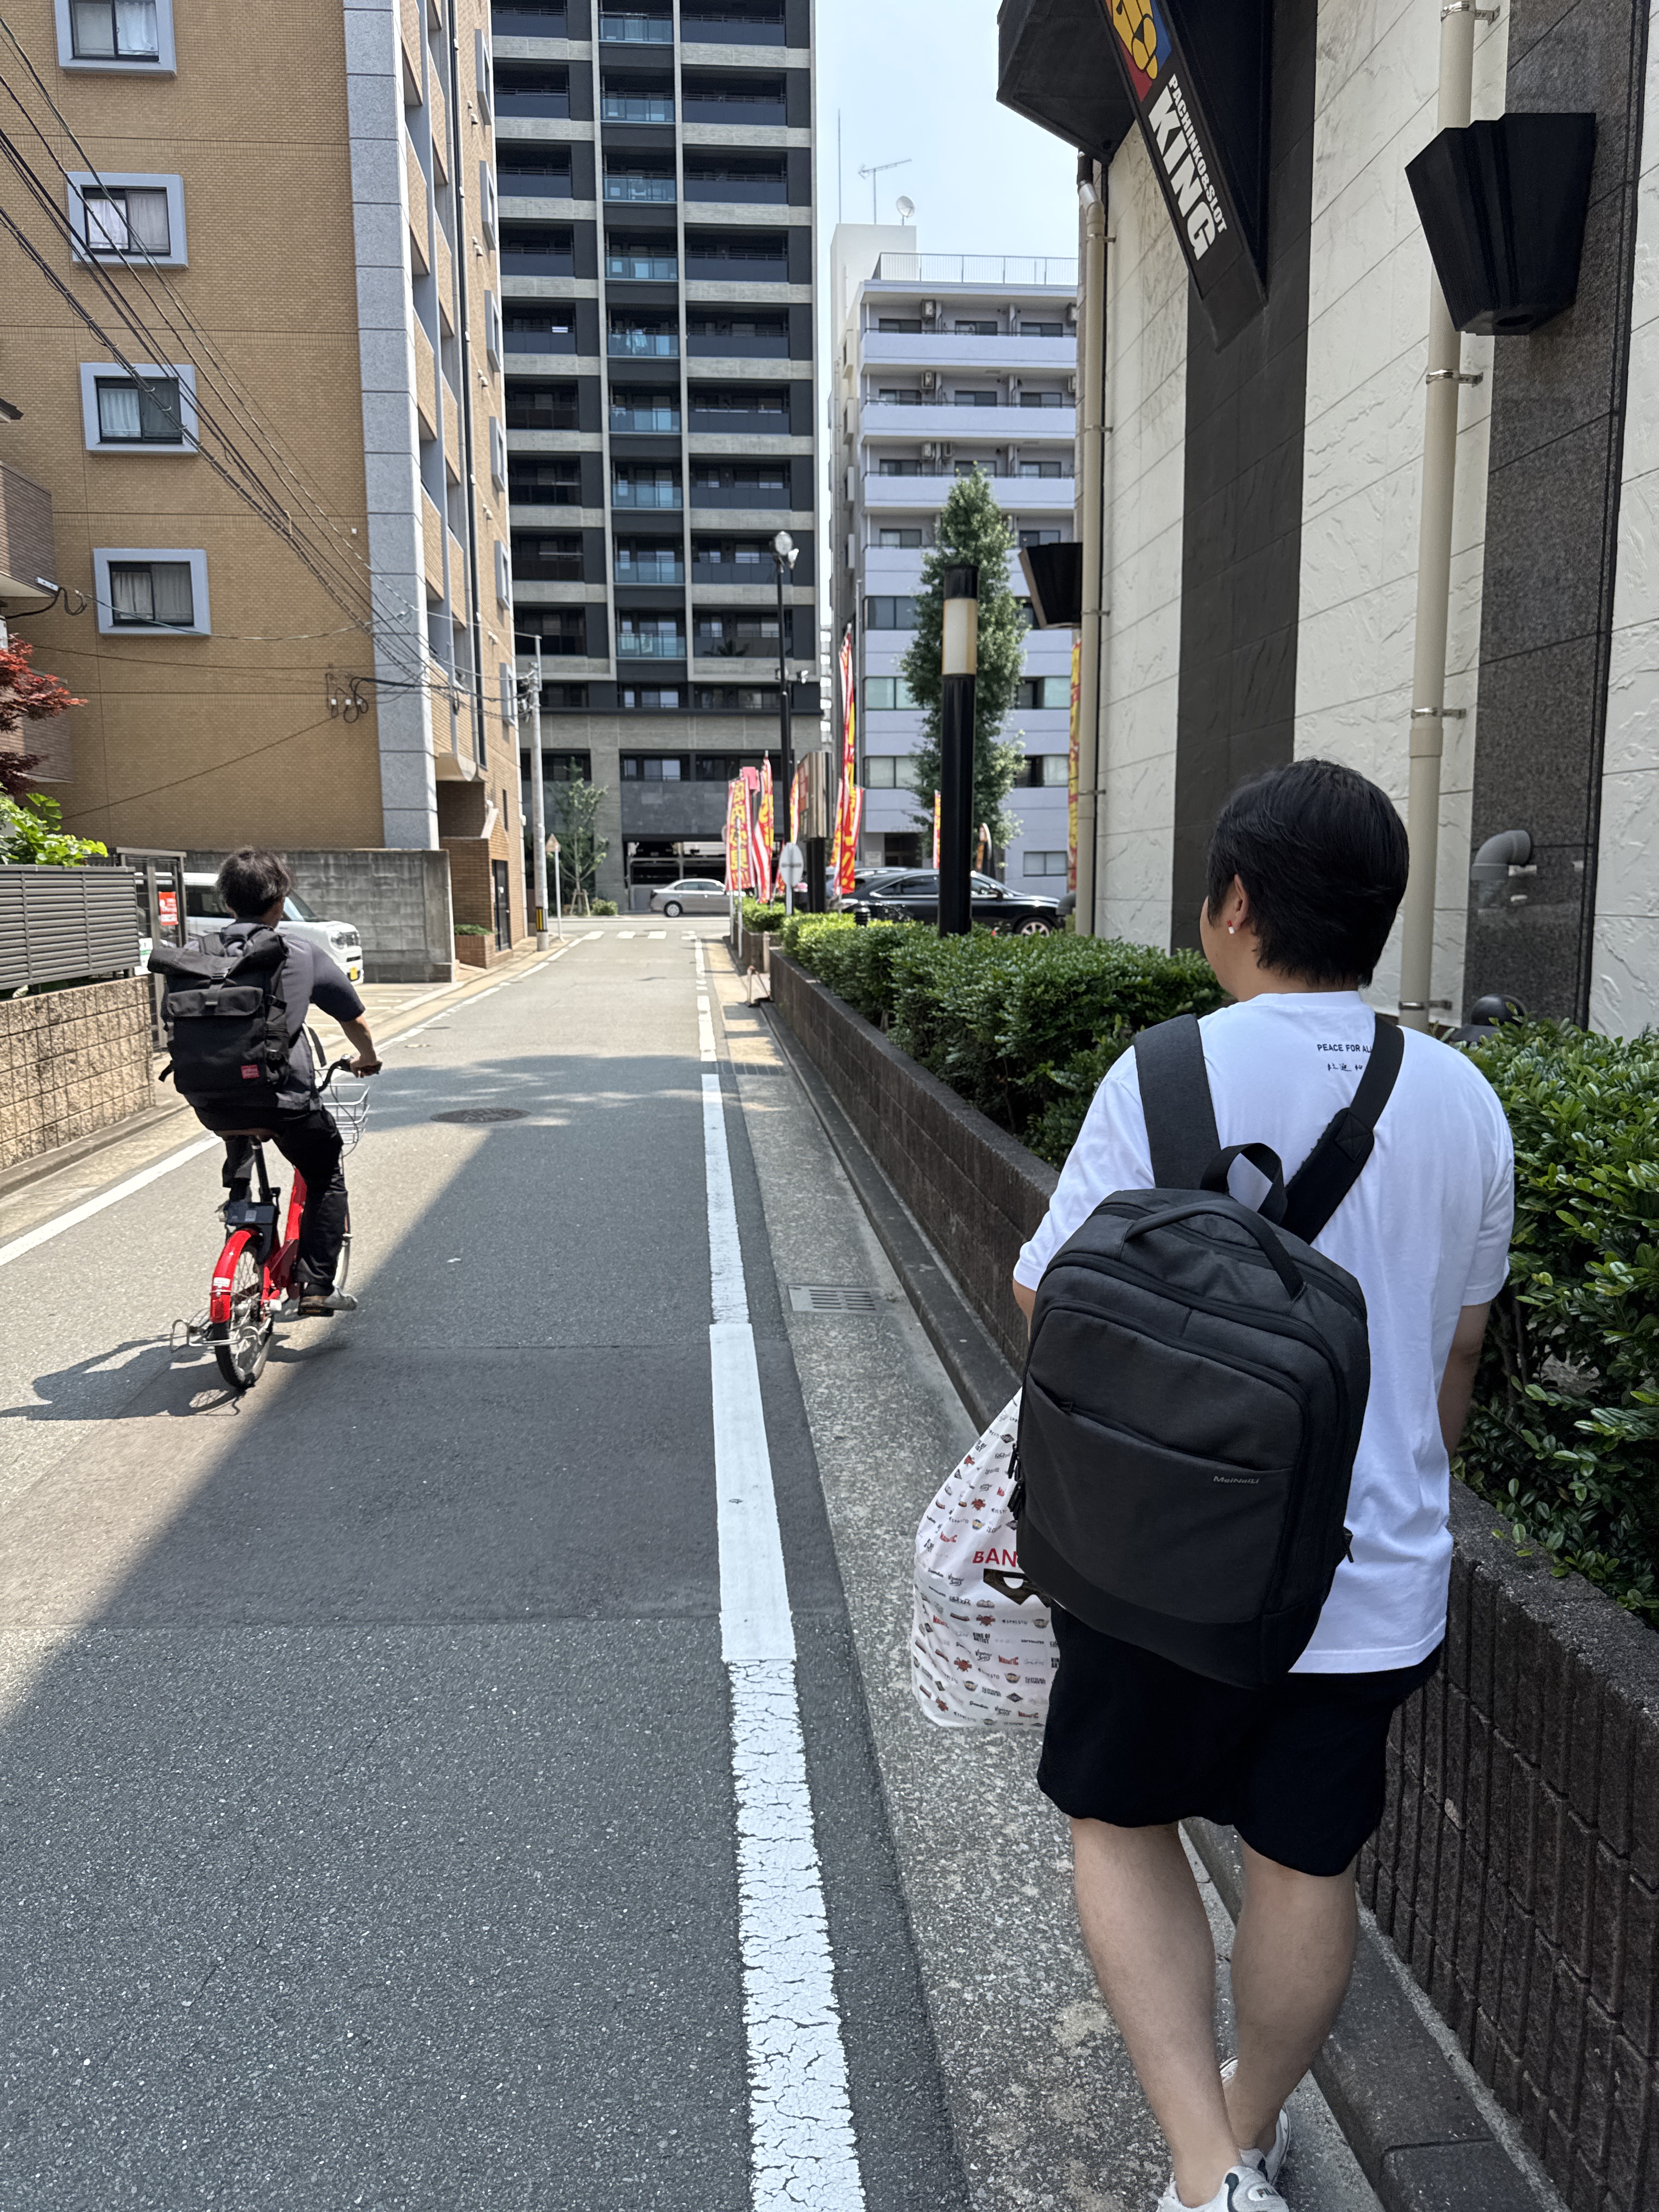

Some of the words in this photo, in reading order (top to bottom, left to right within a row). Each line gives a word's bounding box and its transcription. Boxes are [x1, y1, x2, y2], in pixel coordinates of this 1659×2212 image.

[1148, 86, 1215, 261] KING
[1168, 74, 1227, 233] PACHINKO&SLOT
[1346, 1044, 1361, 1052] FOR
